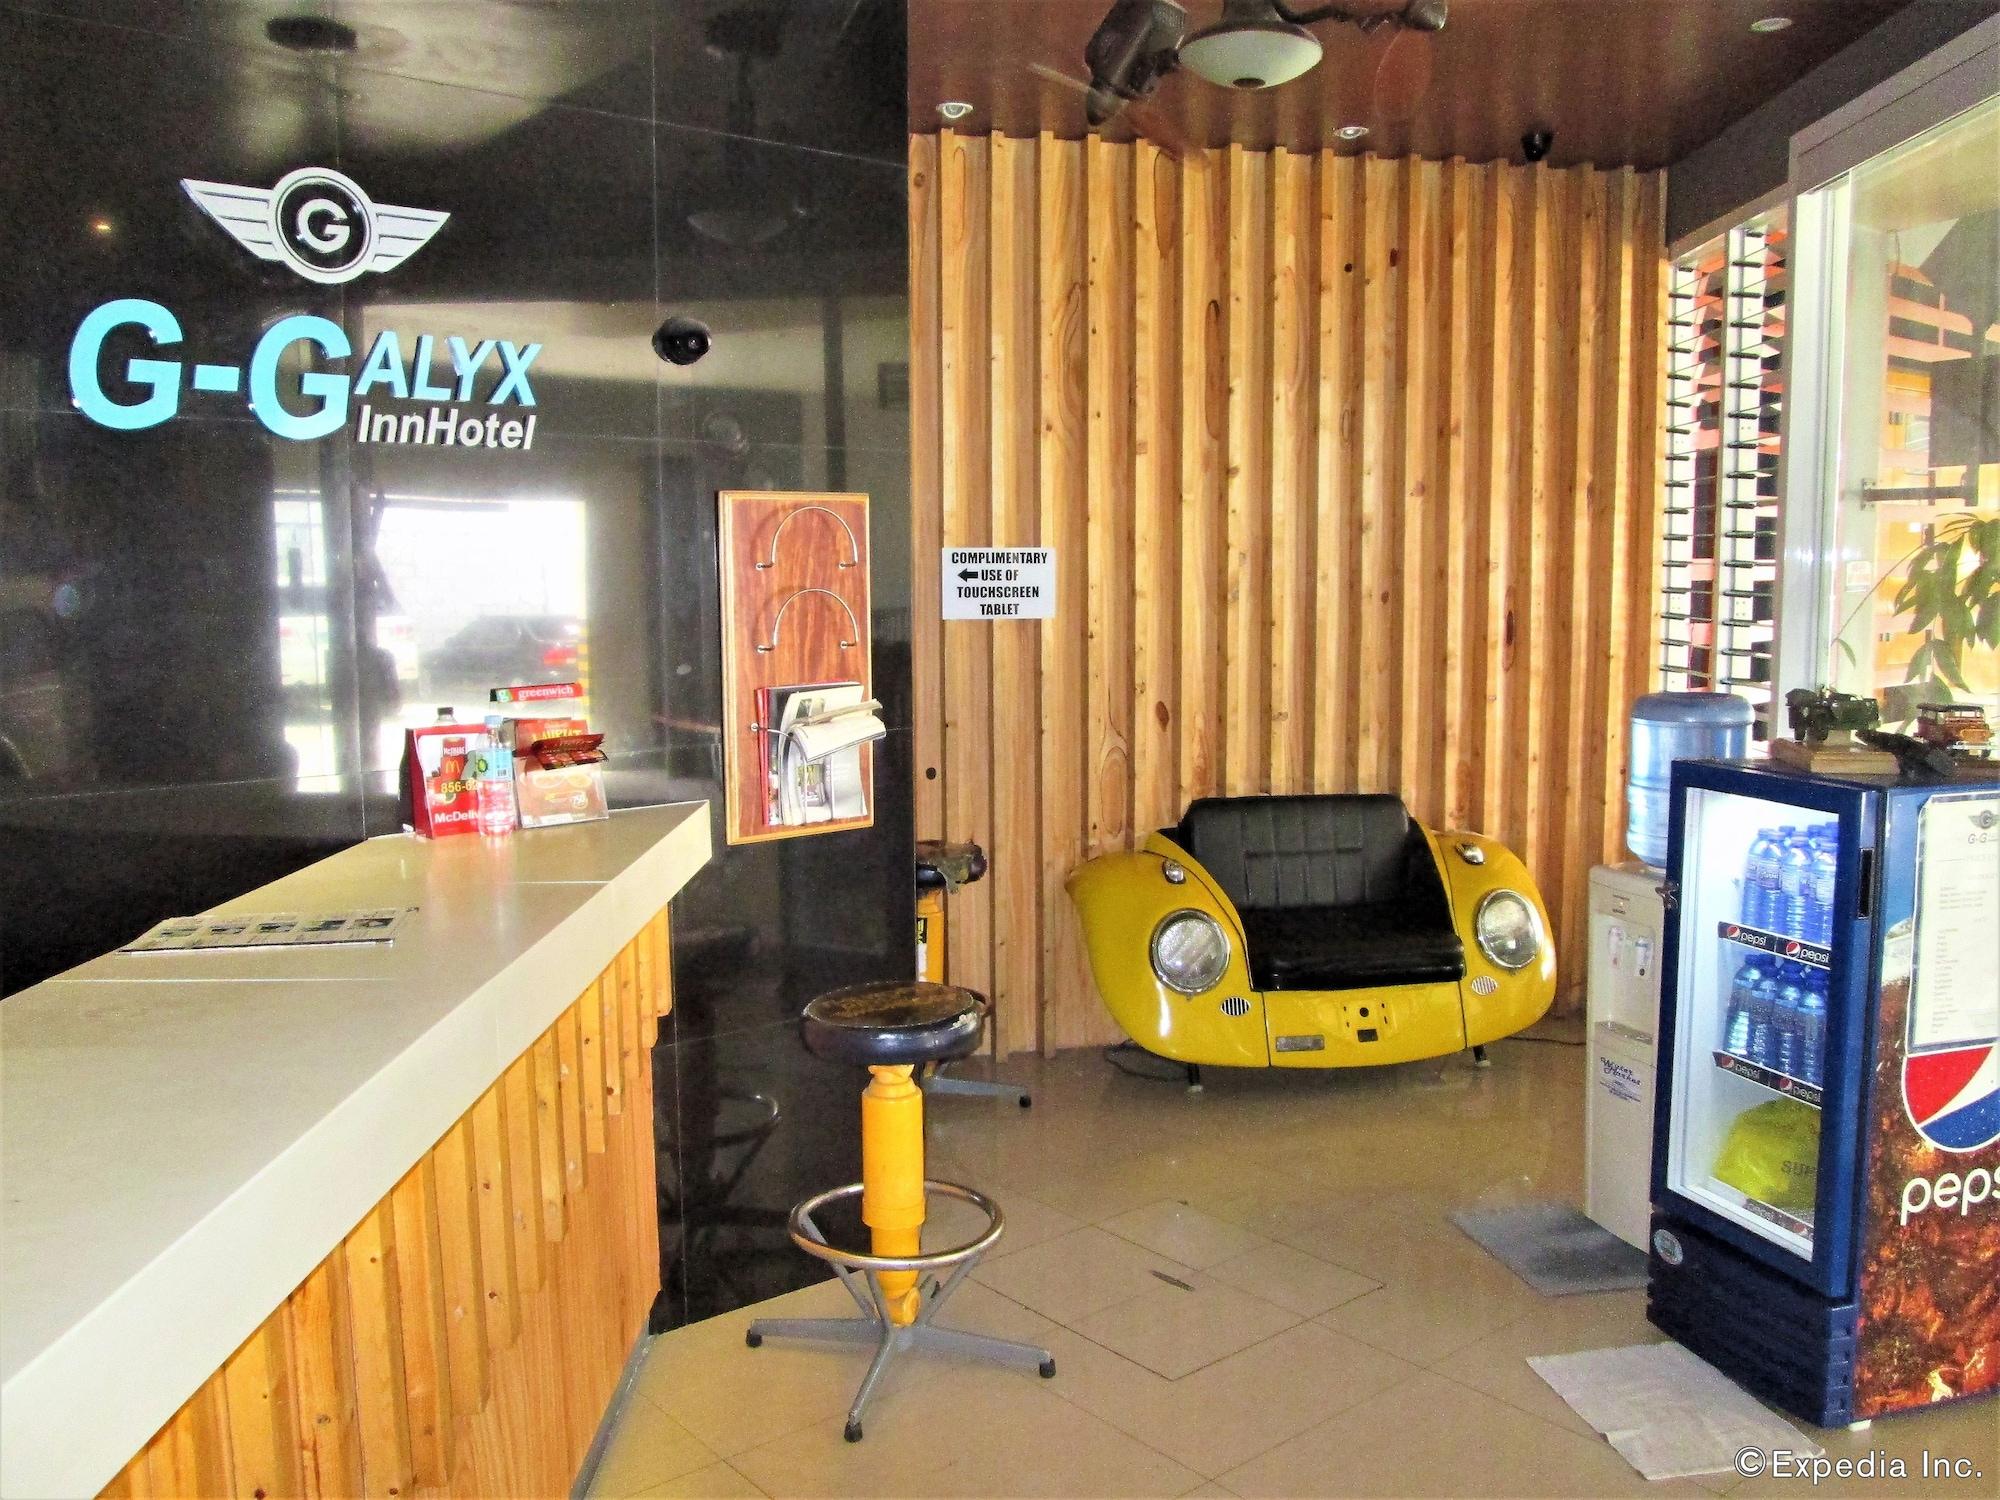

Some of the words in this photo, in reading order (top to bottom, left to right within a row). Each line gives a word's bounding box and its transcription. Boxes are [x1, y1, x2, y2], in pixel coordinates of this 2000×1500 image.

[356, 403, 537, 451] InnHotel
[951, 551, 1048, 564] COMPLIMENTARY
[981, 569, 1003, 581] USE
[1005, 569, 1019, 581] OF
[956, 586, 1040, 599] TOUCHSCREEN
[980, 603, 1020, 615] TABLET
[518, 684, 574, 701] greenwich
[441, 777, 479, 794] 856-62
[434, 808, 481, 824] McDeliv
[1740, 931, 1767, 946] pepsi
[1800, 948, 1830, 963] pepsi
[1735, 1063, 1761, 1079] pepsi
